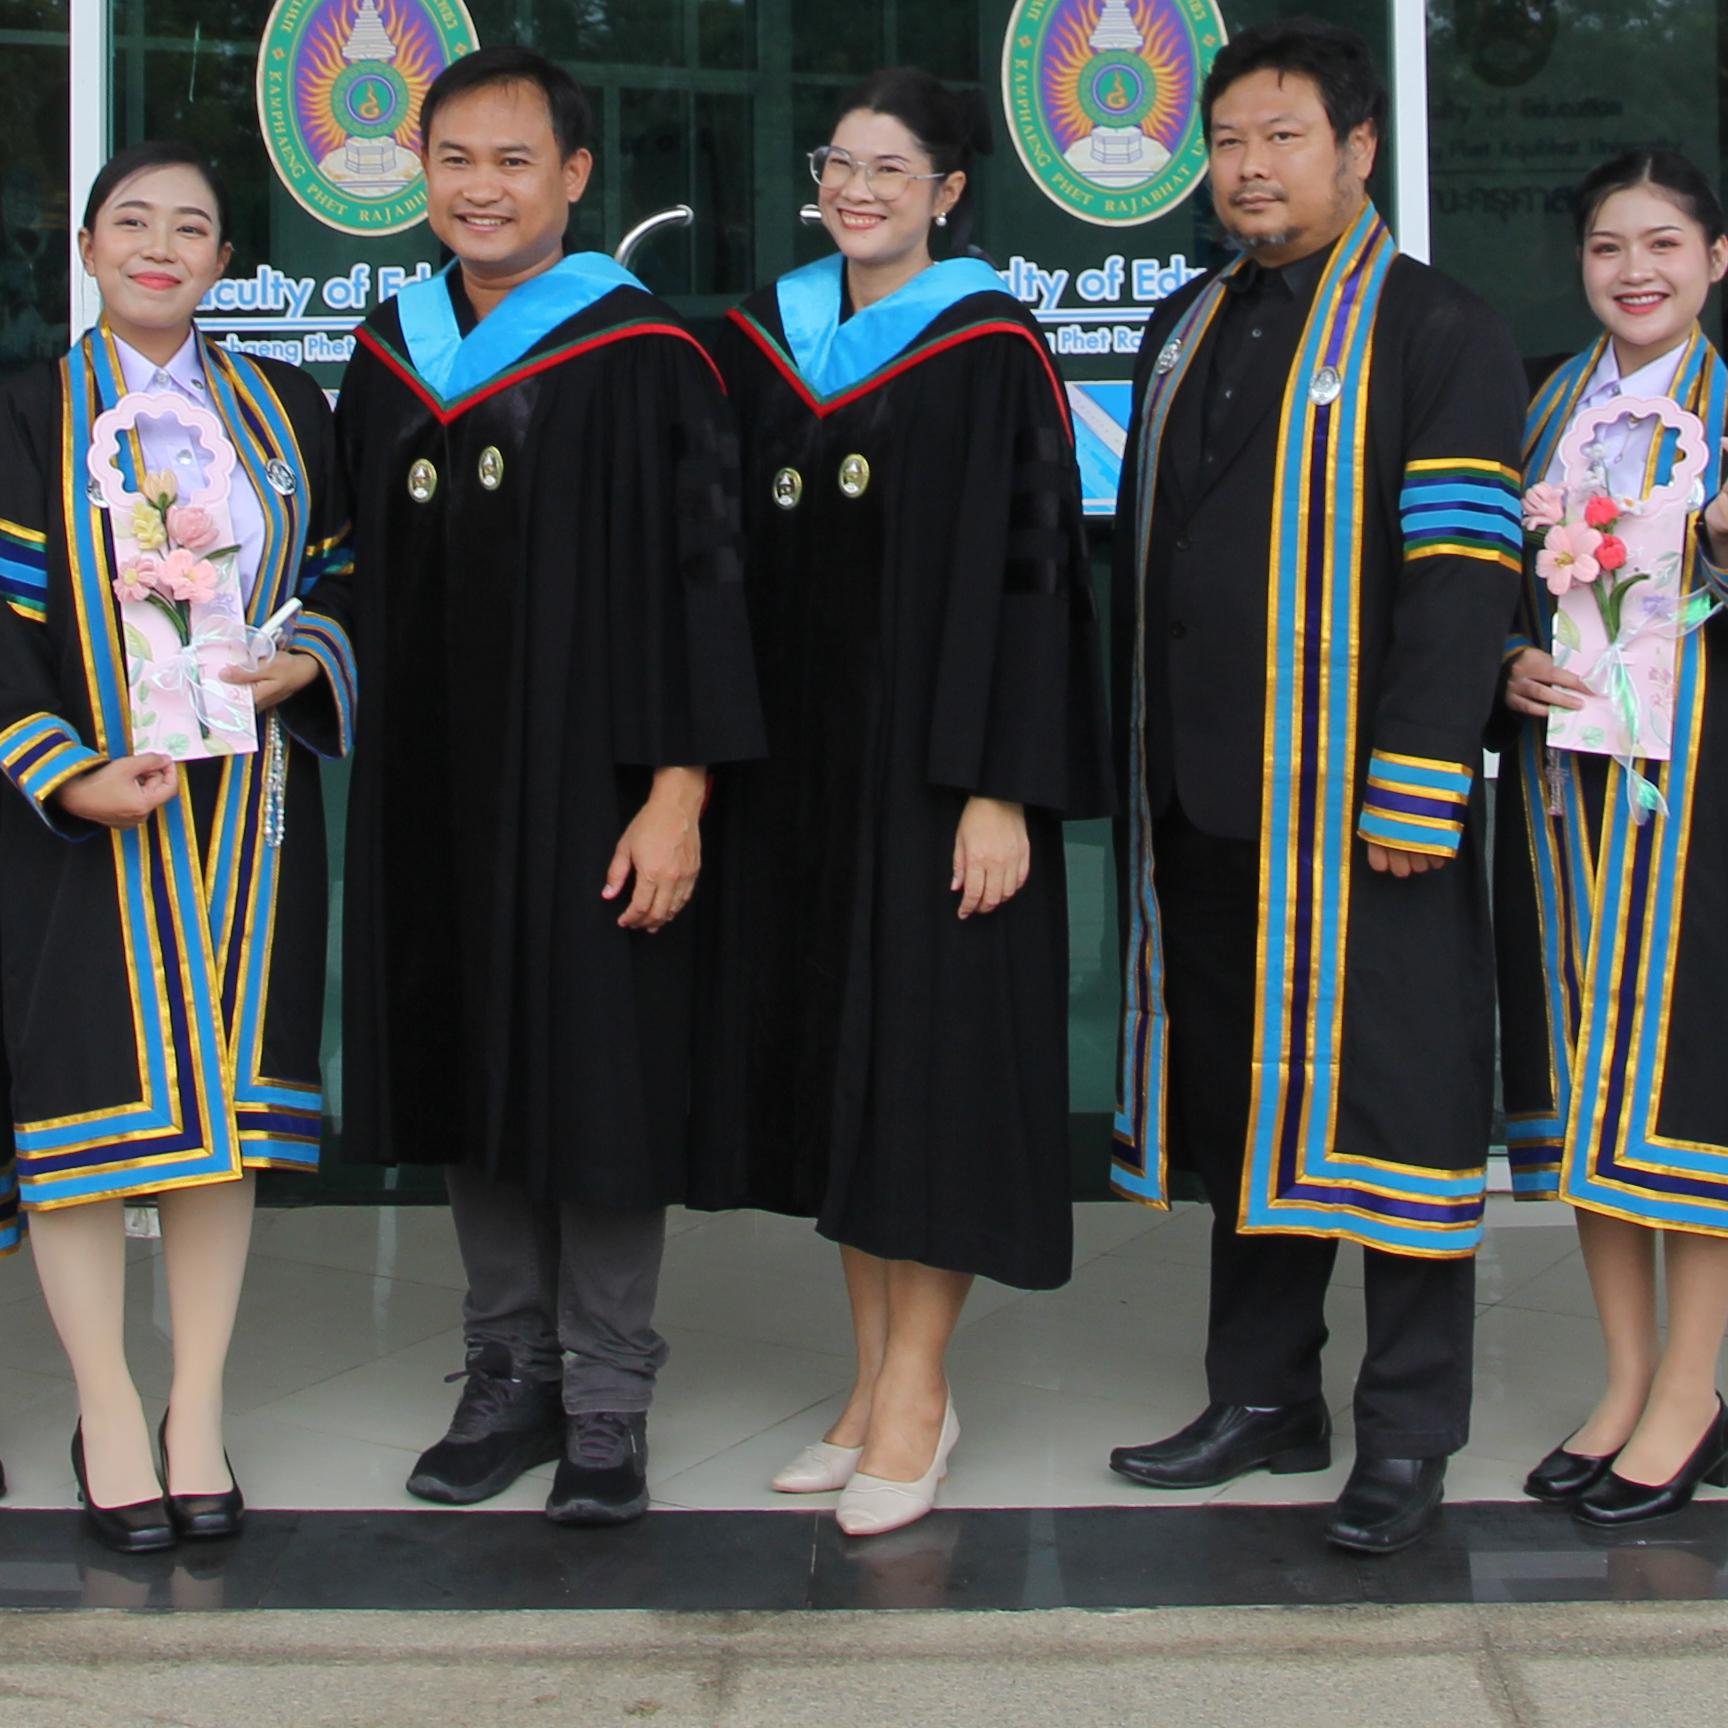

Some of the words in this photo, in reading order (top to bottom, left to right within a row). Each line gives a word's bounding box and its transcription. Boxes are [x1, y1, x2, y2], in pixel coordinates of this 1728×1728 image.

[268, 70, 307, 180] KAMPHAENG
[306, 182, 349, 216] PHET
[358, 190, 428, 224] RAJABH
[1015, 58, 1052, 168] KAMPHAENG
[1052, 171, 1094, 206] PHET
[1104, 165, 1192, 214] RAJABHAT
[323, 263, 371, 308] of
[1076, 255, 1125, 301] of
[1058, 324, 1110, 354] Phet
